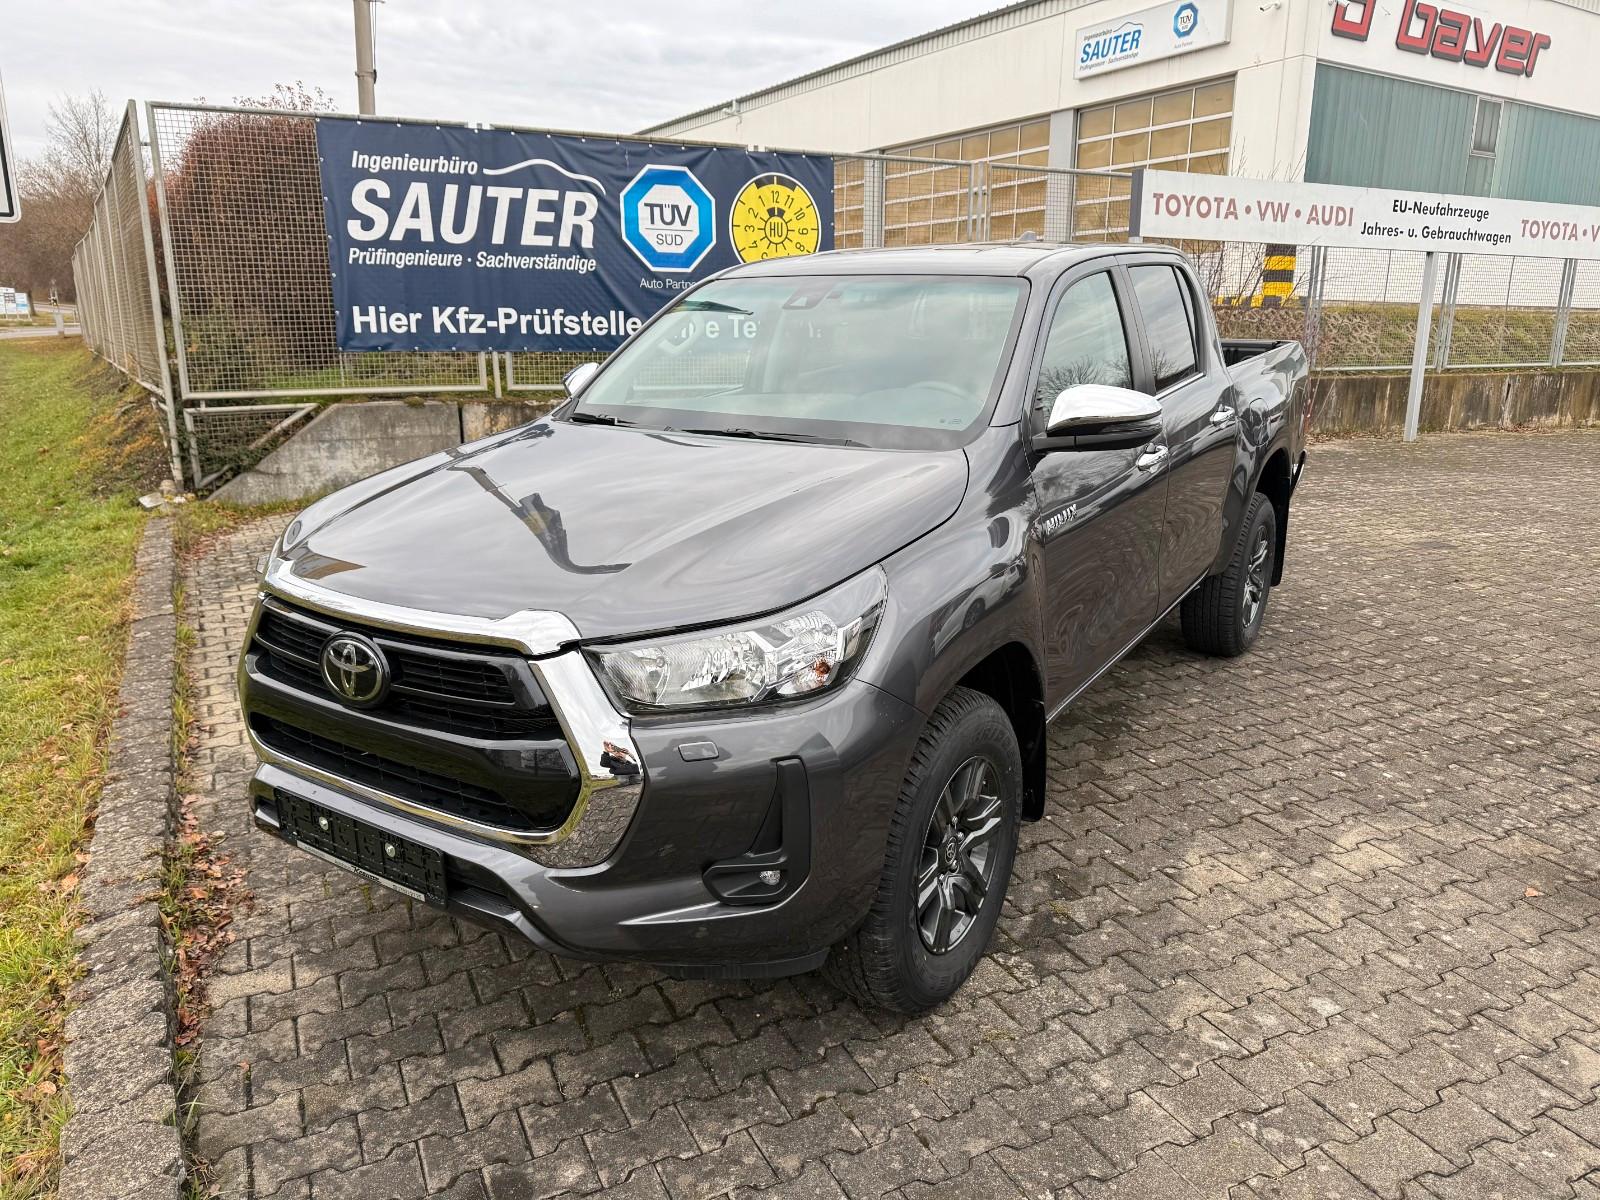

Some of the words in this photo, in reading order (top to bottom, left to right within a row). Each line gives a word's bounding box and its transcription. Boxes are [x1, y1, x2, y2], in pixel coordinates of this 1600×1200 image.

[1081, 29, 1142, 63] SAUTER
[351, 150, 478, 175] Ingenieurbüro
[758, 195, 766, 207] 1
[771, 190, 780, 204] 12
[784, 194, 795, 209] 11
[347, 178, 599, 248] SAUTER
[643, 202, 692, 227] TÜV
[748, 207, 759, 219] 2
[794, 207, 806, 221] 10
[1152, 192, 1239, 220] TOYOTA
[1256, 200, 1290, 223] VW
[1306, 203, 1354, 227] AUDI
[1392, 199, 1490, 222] EU-Neufahrzeuge
[744, 225, 755, 233] 3
[769, 221, 783, 238] HU
[1360, 222, 1404, 238] Jahres-
[1407, 228, 1418, 239] u.
[1421, 225, 1512, 246] Gebrauchtwagen
[1521, 219, 1578, 241] TOYOTA
[1591, 224, 1600, 242] V
[656, 233, 684, 246] SÜD
[748, 240, 758, 249] 4
[795, 241, 805, 252] 8
[349, 247, 463, 269] Prüfingenieure
[476, 251, 597, 273] Sachverständige
[640, 278, 664, 289] Auto
[352, 305, 422, 334] Hier
[432, 305, 643, 337] Kfz-Prüfstelle
